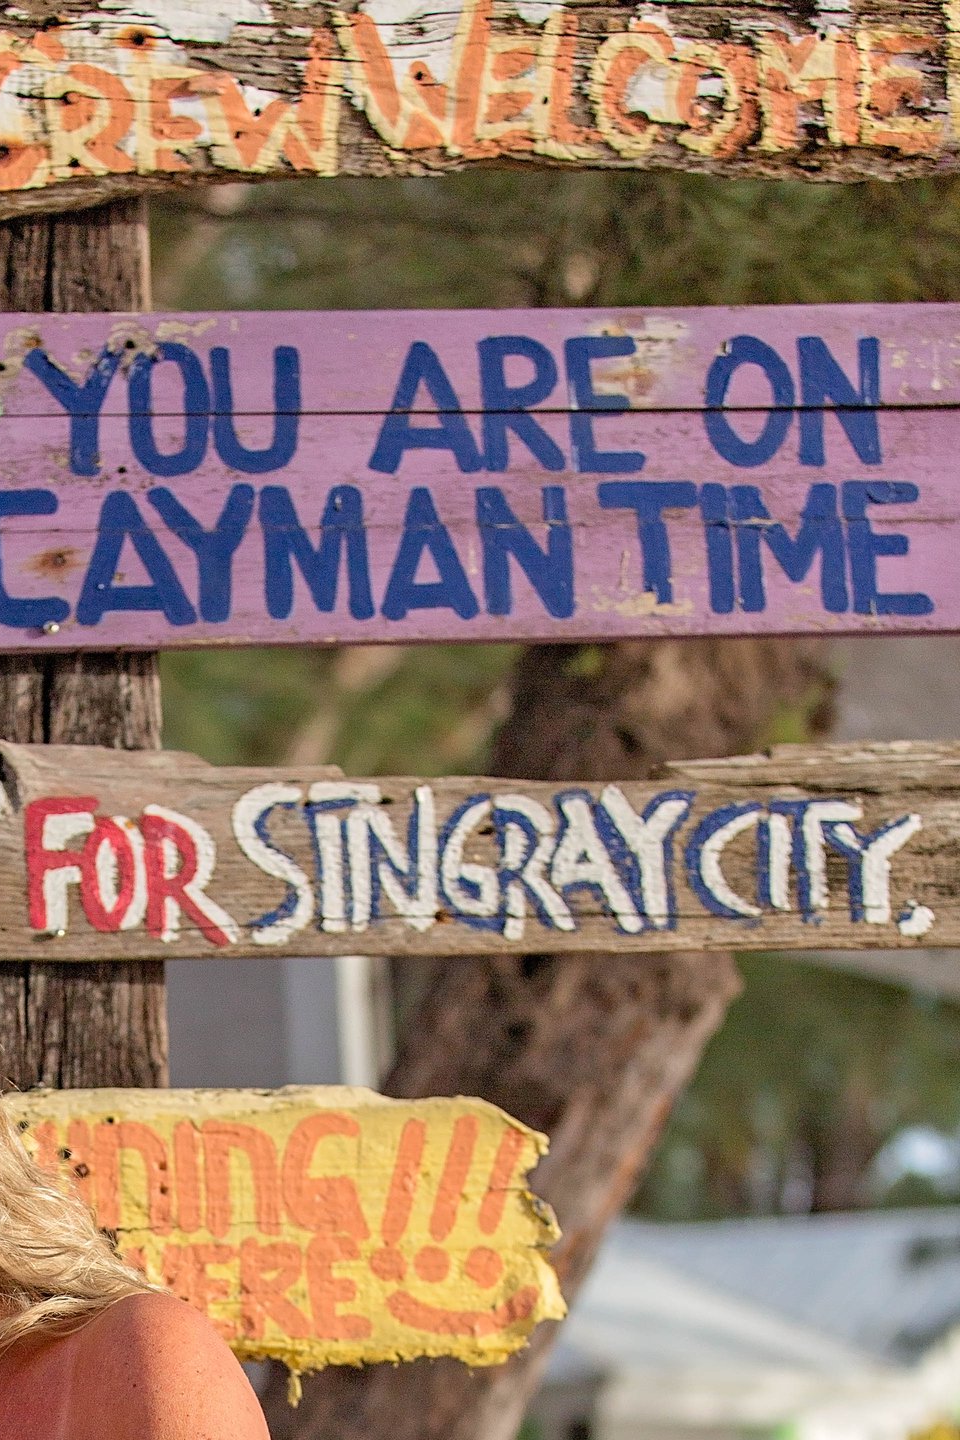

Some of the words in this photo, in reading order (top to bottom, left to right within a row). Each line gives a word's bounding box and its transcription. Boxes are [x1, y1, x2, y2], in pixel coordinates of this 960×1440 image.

[331, 0, 946, 160] WELCOME
[22, 335, 301, 477] YOU
[368, 335, 646, 473] ARE
[703, 335, 883, 467] ON
[596, 480, 935, 617] TIME
[24, 796, 240, 947] FOR
